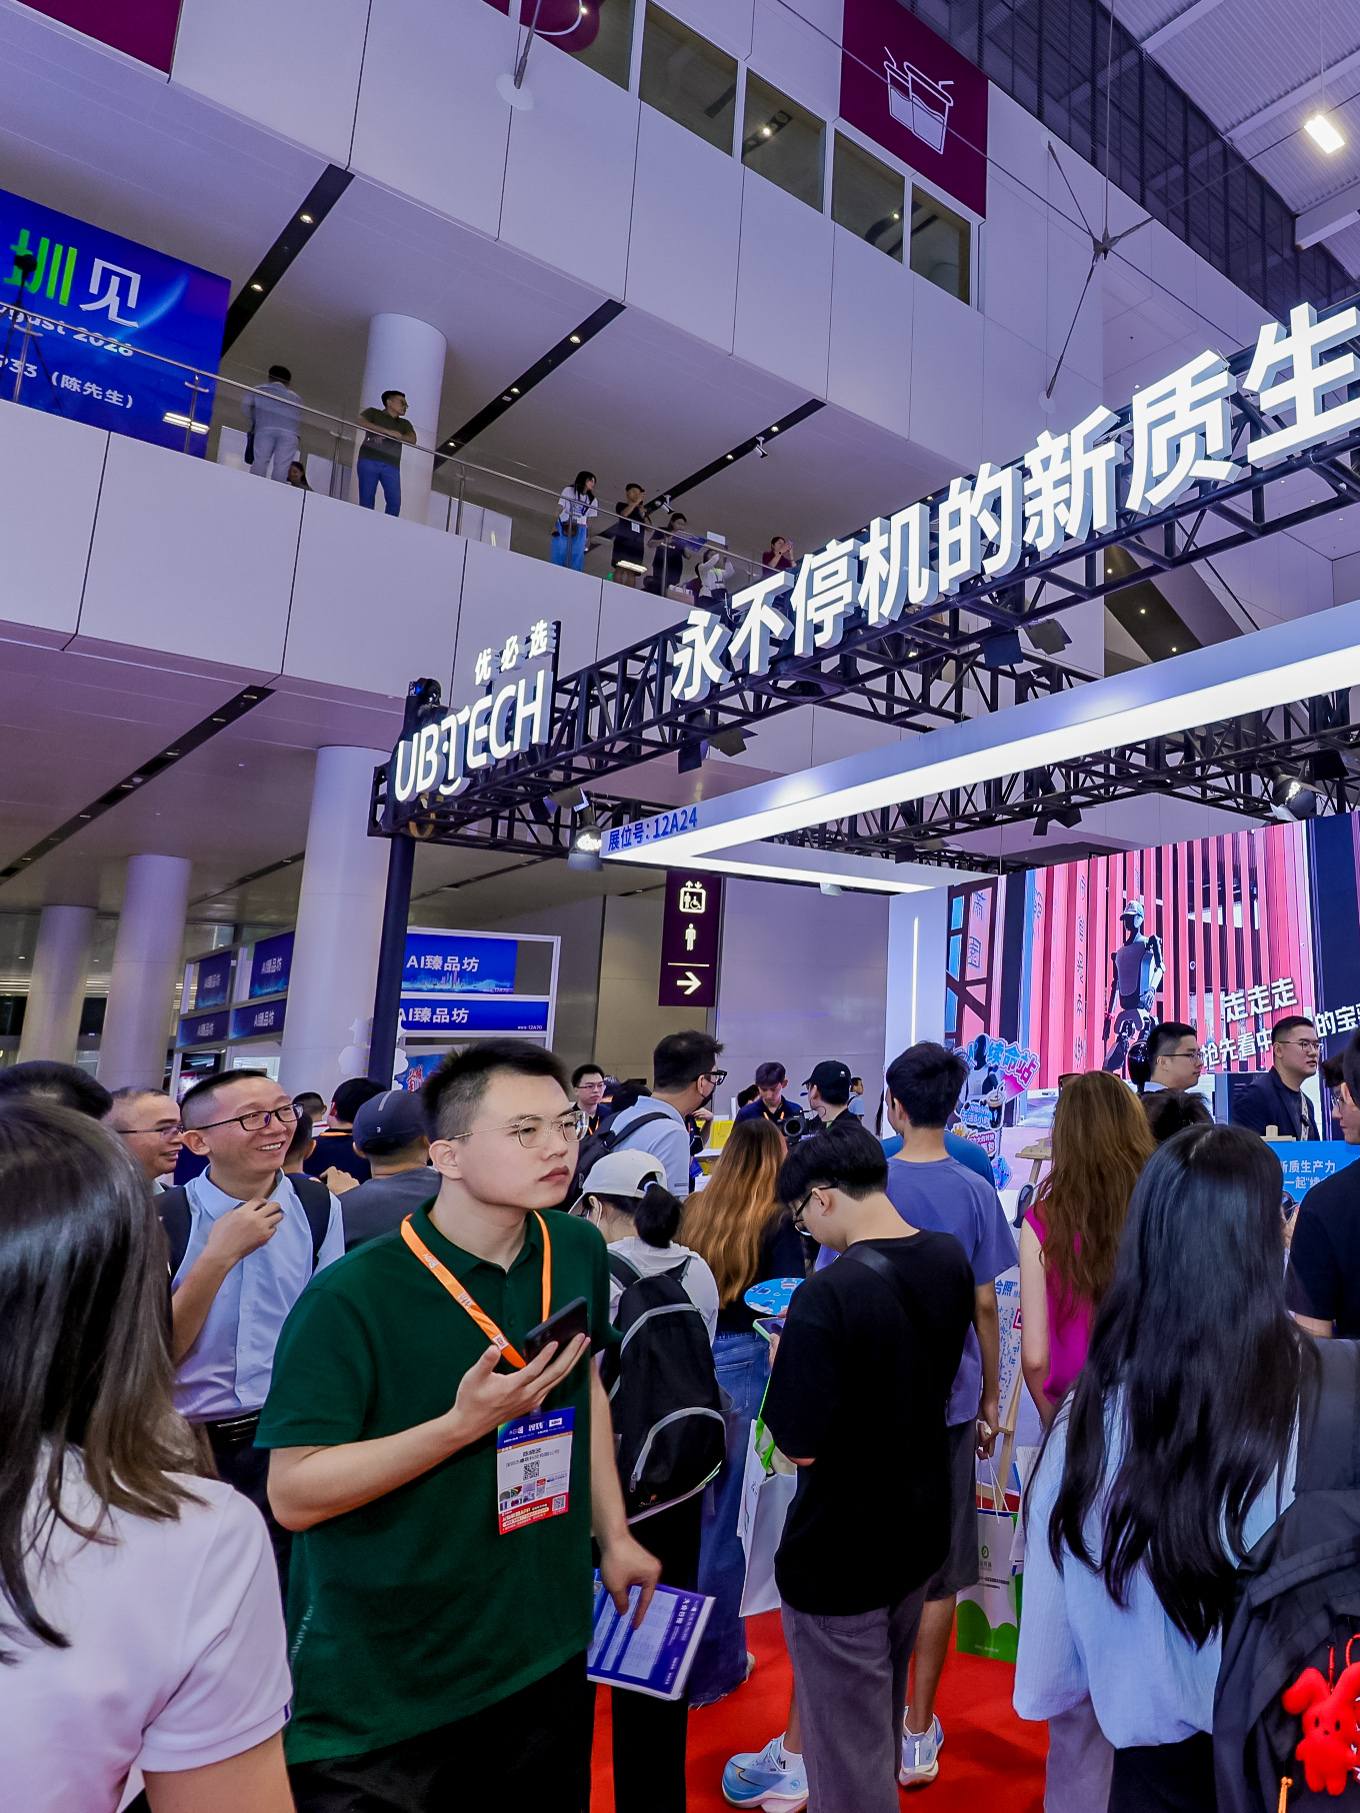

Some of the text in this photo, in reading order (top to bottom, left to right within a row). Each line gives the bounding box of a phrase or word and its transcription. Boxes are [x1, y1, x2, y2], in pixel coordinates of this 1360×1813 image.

[475, 619, 550, 686] 优必选
[406, 955, 480, 973] AI臻品坊
[1222, 977, 1298, 1023] 走走走
